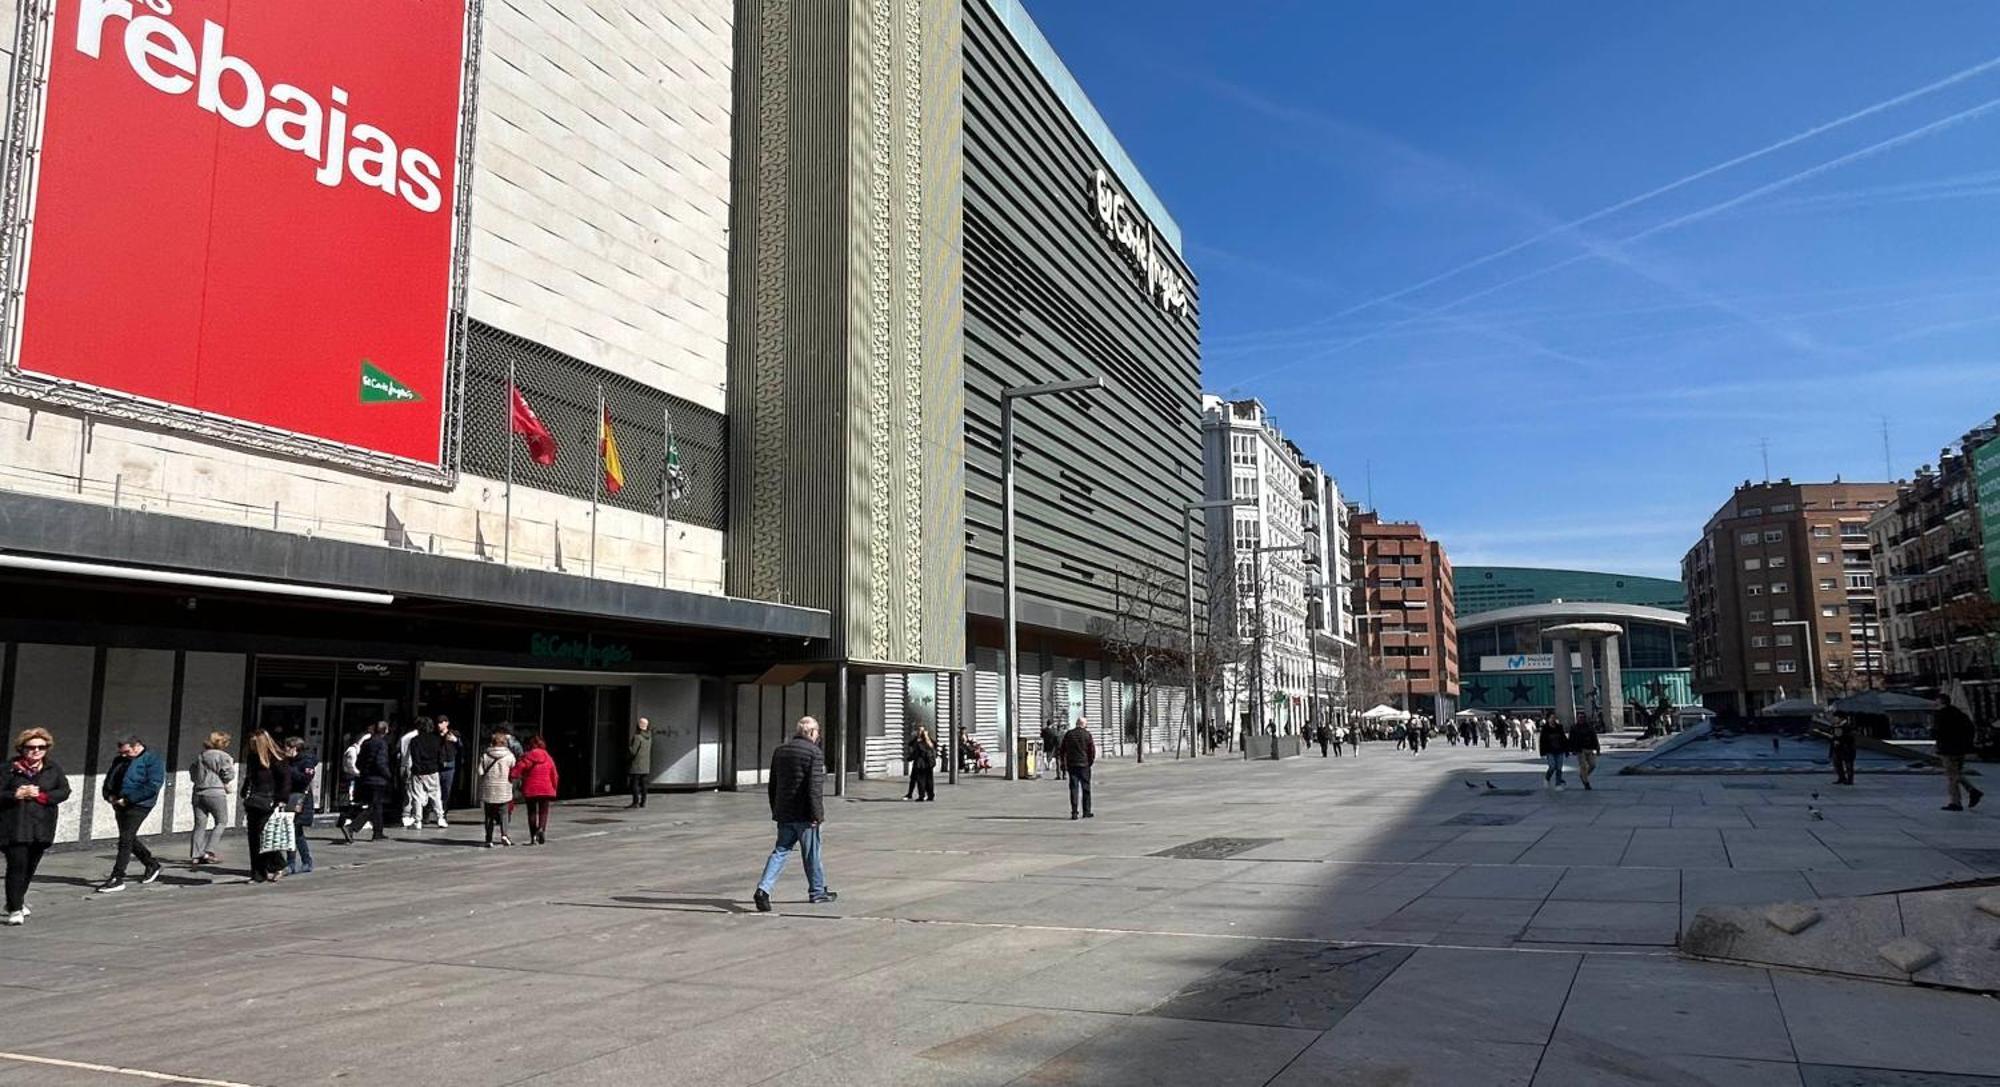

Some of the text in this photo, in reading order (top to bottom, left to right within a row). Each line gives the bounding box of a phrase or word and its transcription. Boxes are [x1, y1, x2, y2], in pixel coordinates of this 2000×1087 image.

[76, 0, 442, 213] rebajas
[1096, 168, 1188, 317] El Corte Inglés
[548, 634, 586, 657] Corte
